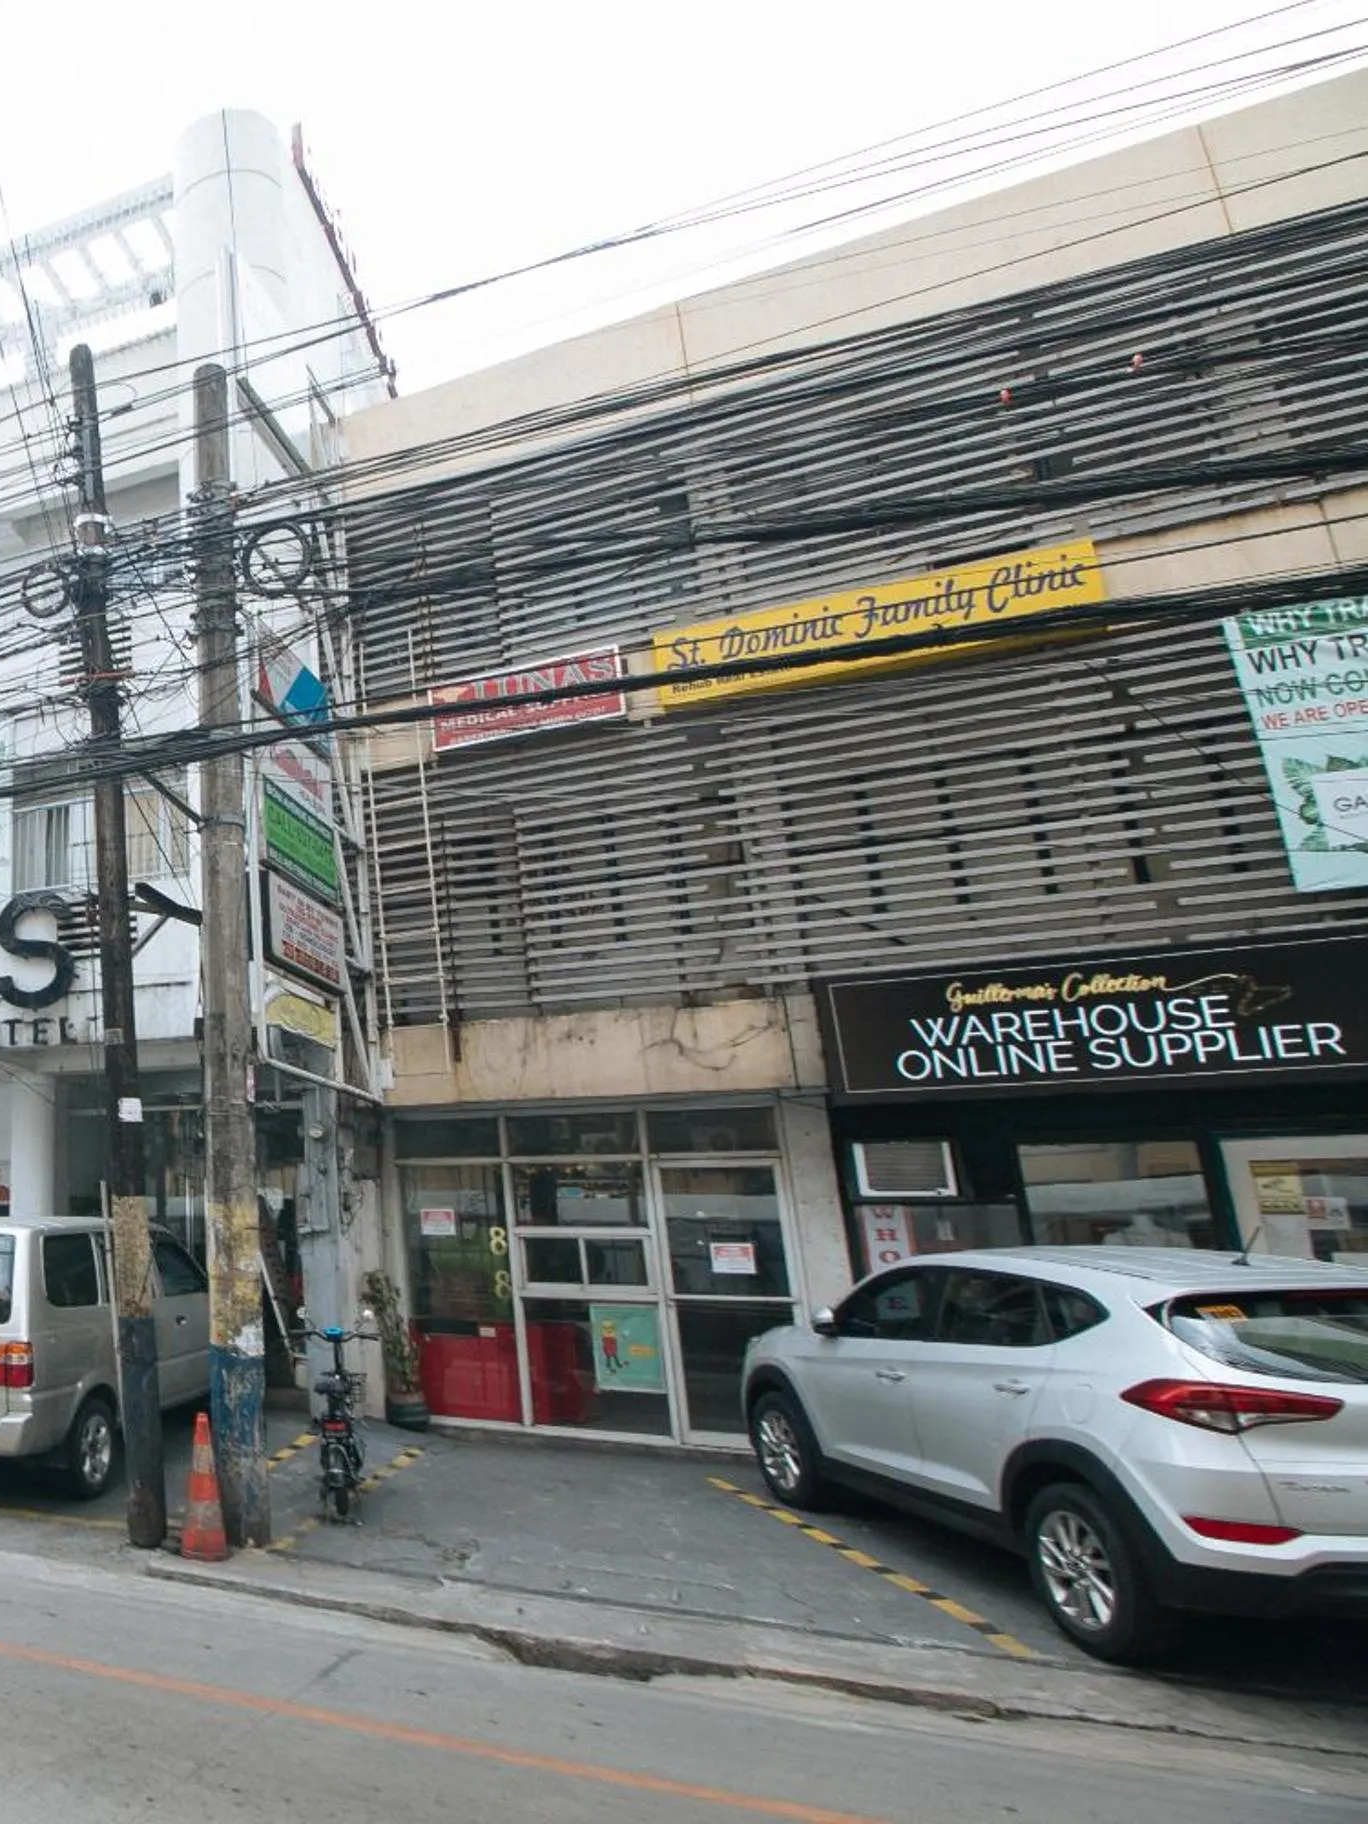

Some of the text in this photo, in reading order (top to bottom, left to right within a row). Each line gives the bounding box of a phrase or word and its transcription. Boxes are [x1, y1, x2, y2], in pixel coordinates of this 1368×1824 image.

[667, 553, 1087, 674] St. Dominic Family Clinic
[1246, 640, 1318, 674] WHY
[1254, 676, 1318, 708] NOW
[441, 707, 518, 731] MEDICAL
[1260, 712, 1289, 731] WE
[1293, 704, 1330, 724] ARE
[1061, 972, 1168, 1002] Collection
[911, 993, 1236, 1050] WAREHOUSE
[896, 1020, 1347, 1082] ONLINE SUPPLIER
